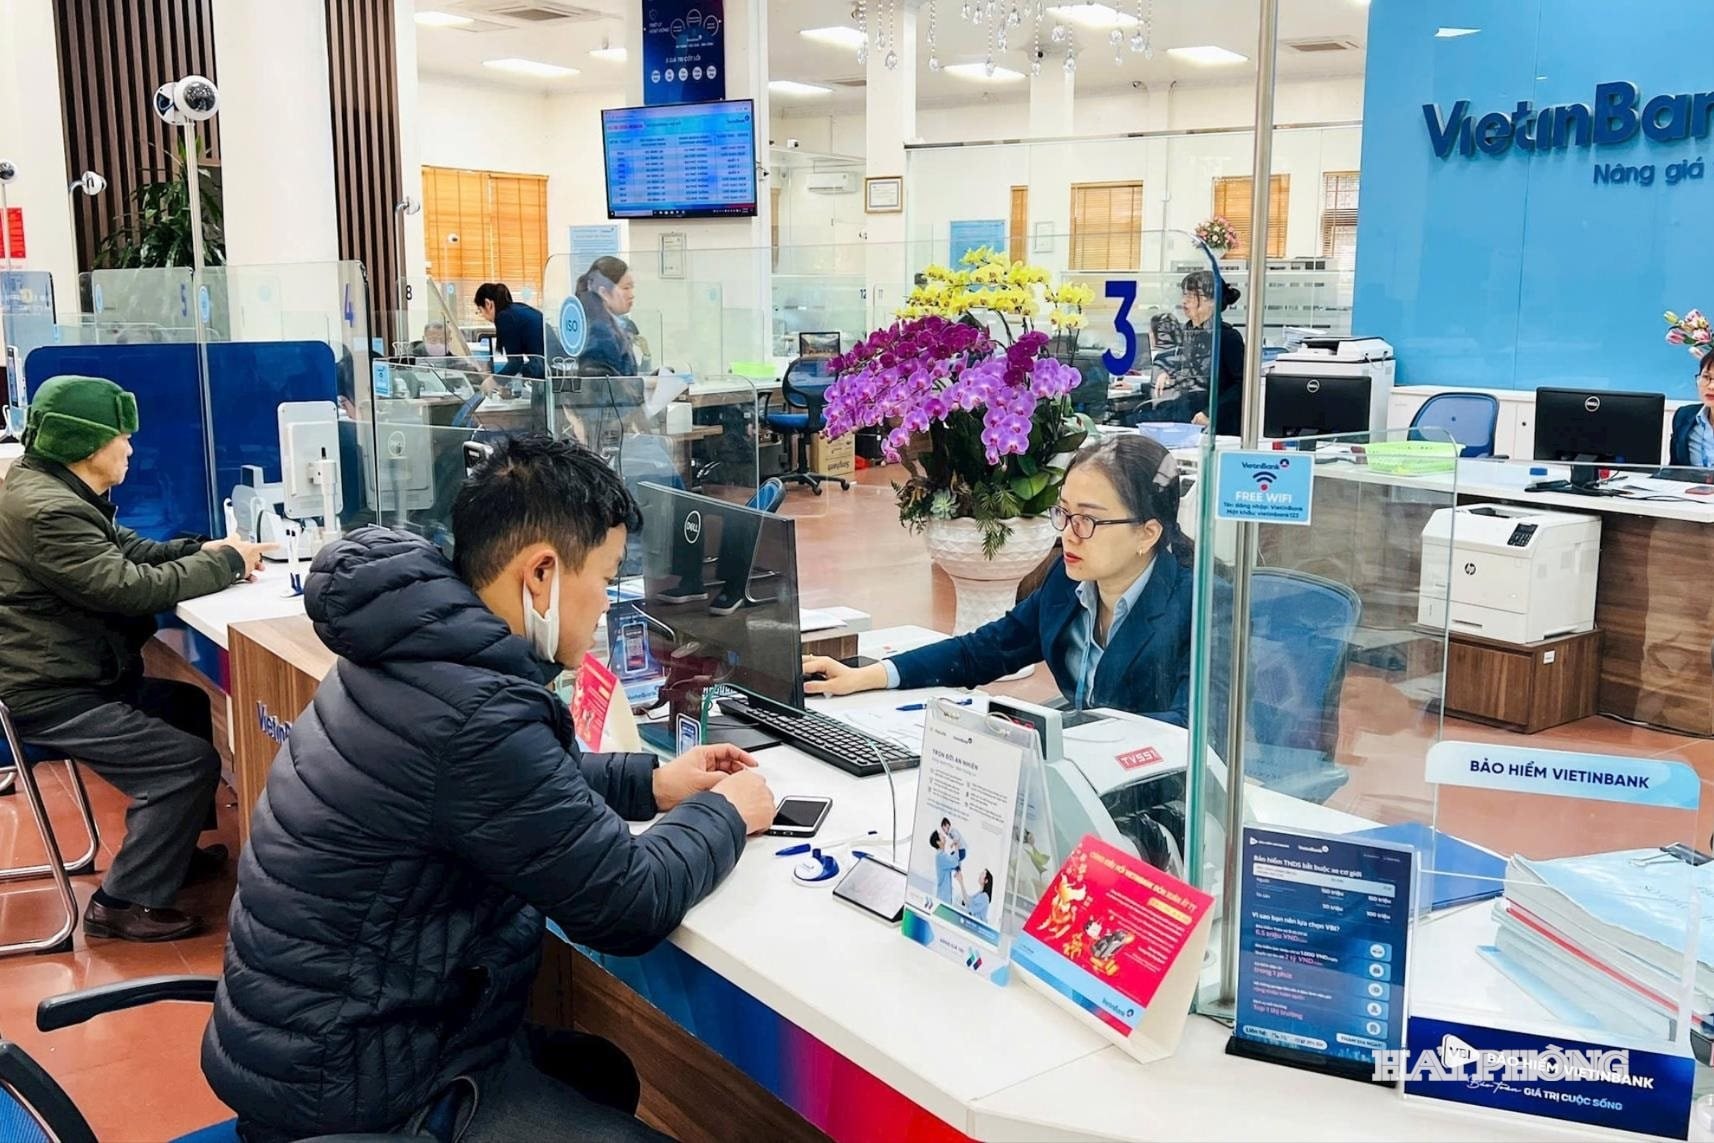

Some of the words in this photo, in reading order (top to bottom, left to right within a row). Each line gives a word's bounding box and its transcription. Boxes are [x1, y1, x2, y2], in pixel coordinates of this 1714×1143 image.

[1593, 162, 1645, 186] Nâng
[1665, 156, 1705, 186] giá
[405, 285, 412, 301] 8
[1102, 280, 1137, 377] 3
[1242, 461, 1280, 470] VietinBank
[1235, 491, 1264, 503] FREE
[1266, 493, 1293, 503] WIFI
[686, 522, 699, 533] DELL
[1470, 756, 1505, 775] BẢO
[1508, 760, 1548, 780] HIỂM
[1552, 767, 1650, 790] VIETINBANK
[1448, 1045, 1472, 1060] VBI
[1522, 1057, 1559, 1074] HIỂM
[1563, 1064, 1655, 1090] VIETINBANK
[1523, 1086, 1543, 1098] GIÁ
[1543, 1089, 1560, 1103] TRỊ
[1561, 1092, 1592, 1106] CUỘC
[1592, 1097, 1624, 1111] SỐNG
